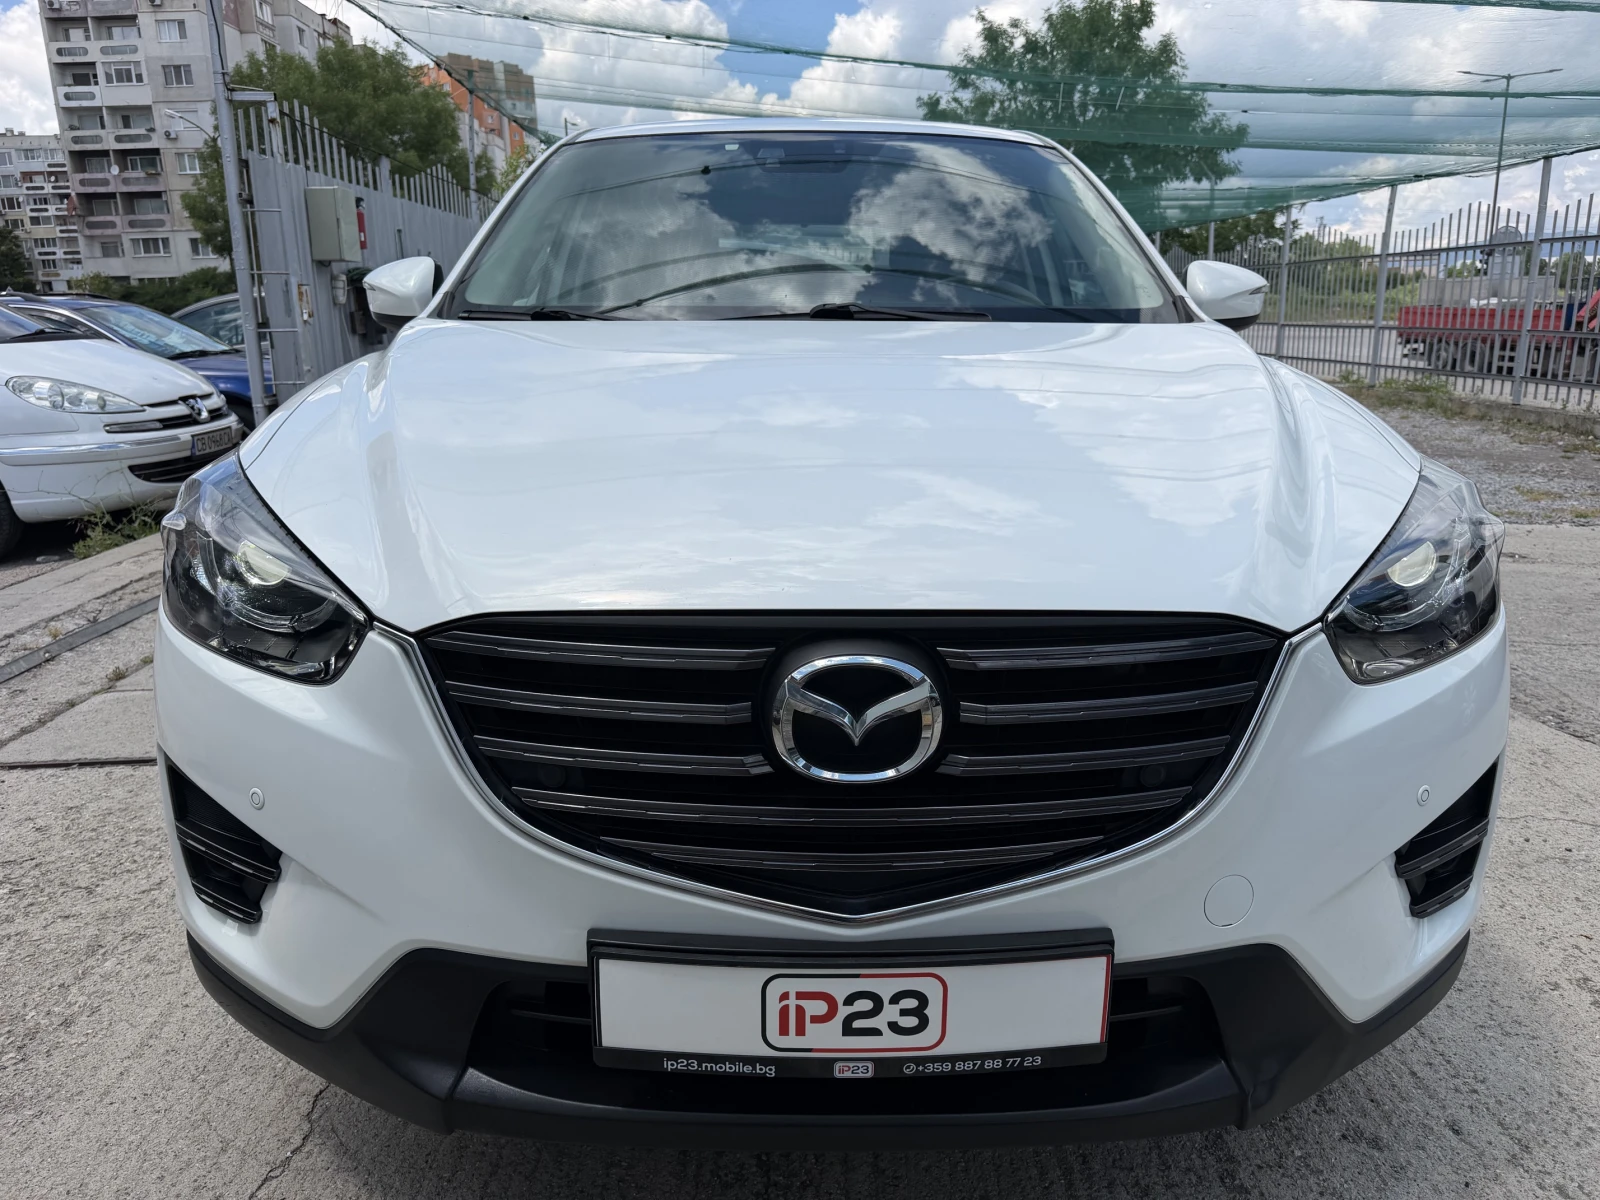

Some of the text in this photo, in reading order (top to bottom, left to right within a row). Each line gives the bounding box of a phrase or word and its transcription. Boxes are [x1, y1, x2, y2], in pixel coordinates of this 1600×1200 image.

[196, 437, 206, 452] CB
[663, 1057, 776, 1077] ip23.mobile.bg
[917, 1056, 1042, 1073] +359 887 88 77 23
